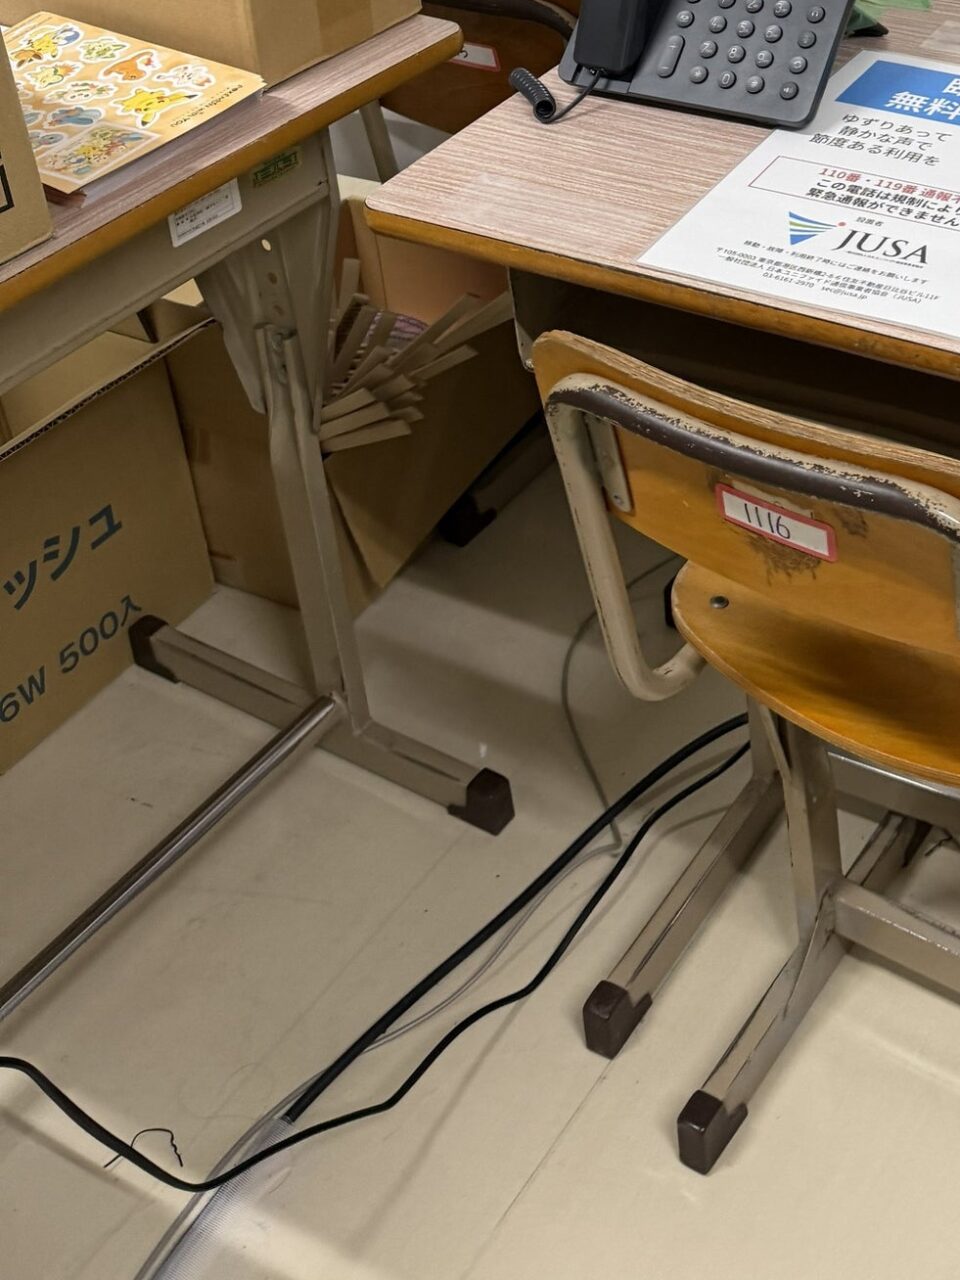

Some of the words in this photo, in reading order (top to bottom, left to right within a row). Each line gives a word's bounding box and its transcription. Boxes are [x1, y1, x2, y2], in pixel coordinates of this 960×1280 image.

[837, 125, 935, 151] 静かな声で
[842, 113, 953, 142] ゆずりあって
[808, 133, 941, 166] 節度ある利用を
[805, 187, 960, 228] 緊急通報ができません
[831, 230, 929, 264] JUSA
[743, 503, 791, 540] 1116
